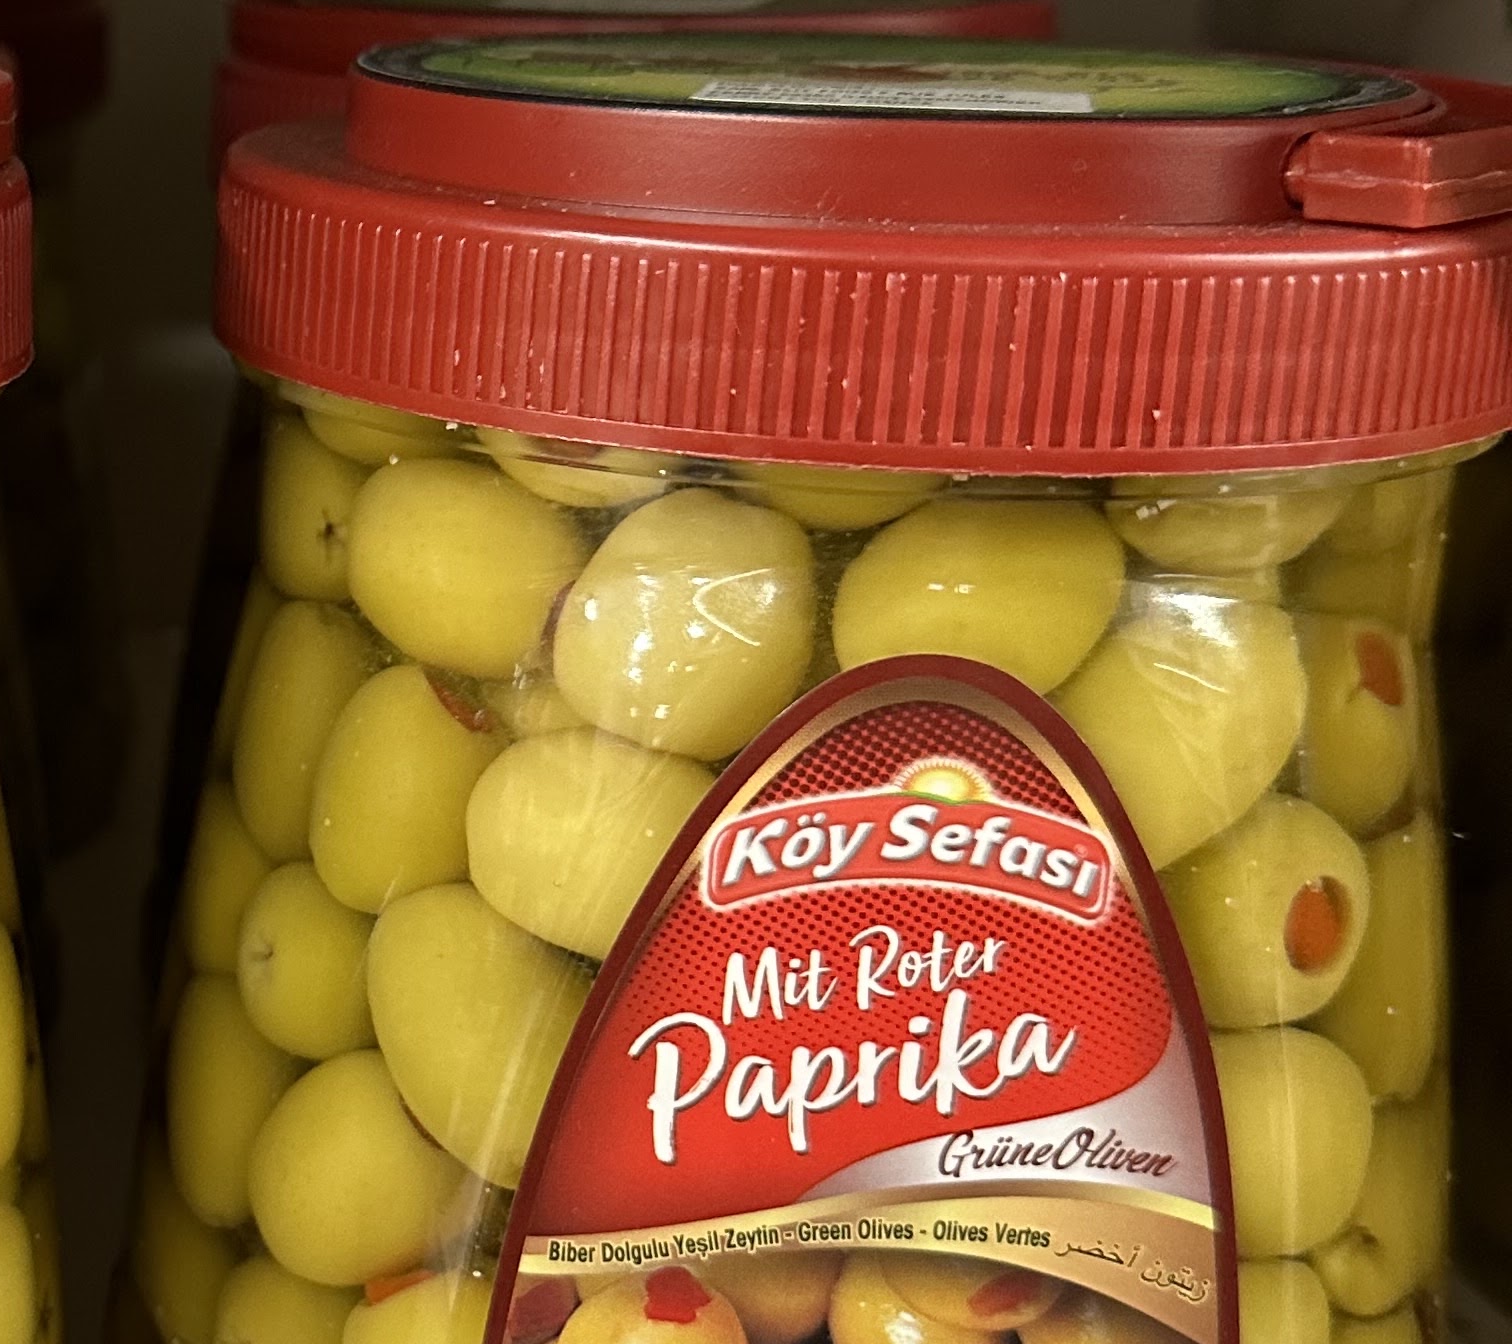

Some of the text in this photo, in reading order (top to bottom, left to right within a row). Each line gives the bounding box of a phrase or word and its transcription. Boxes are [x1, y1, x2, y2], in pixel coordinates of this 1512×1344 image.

[721, 812, 873, 887] Köy
[721, 923, 1005, 1026] Mit Roter
[629, 989, 1077, 1166] Paprika
[548, 1241, 595, 1262] Biber
[602, 1238, 670, 1264] Dolgulu
[673, 1230, 719, 1257] Yeşil
[726, 1226, 779, 1253] Zeytin
[798, 1221, 851, 1242] Green
[859, 1218, 913, 1239] Olives
[933, 1220, 988, 1242] Olives
[995, 1223, 1051, 1247] Vertes
